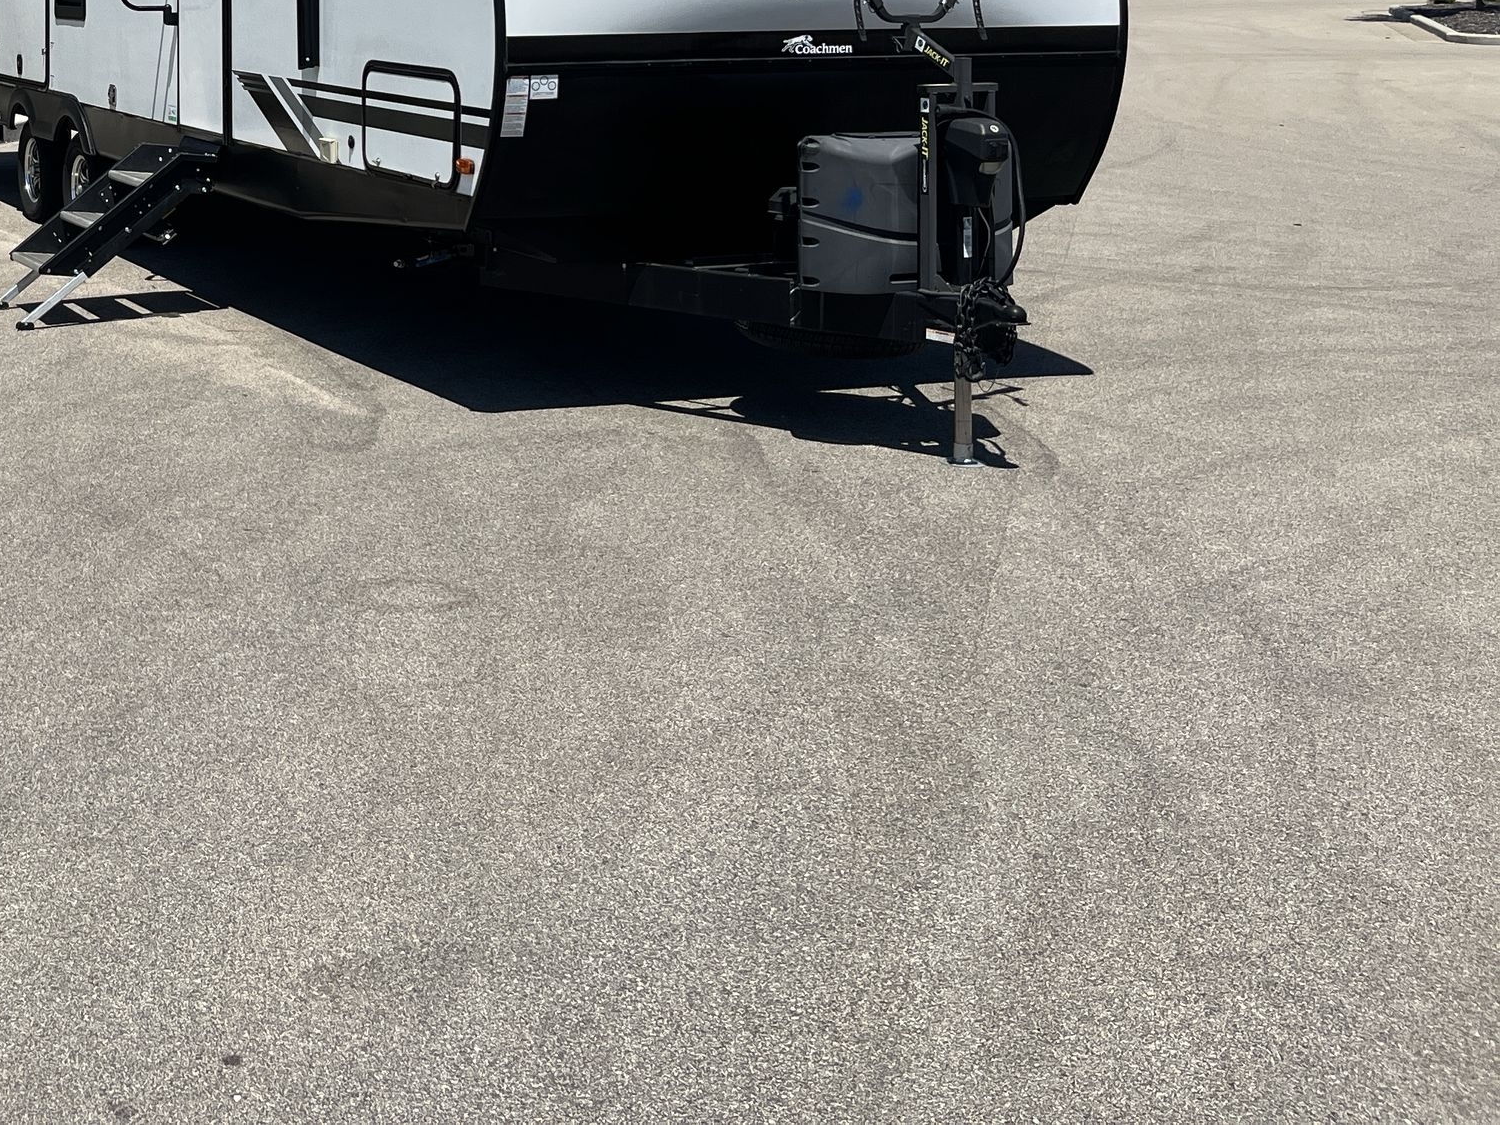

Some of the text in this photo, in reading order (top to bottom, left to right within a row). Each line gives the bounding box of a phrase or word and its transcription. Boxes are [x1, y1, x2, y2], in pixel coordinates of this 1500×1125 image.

[795, 43, 853, 54] Coachmen
[924, 45, 950, 67] JACK-IT
[921, 116, 929, 161] JACK-IT
